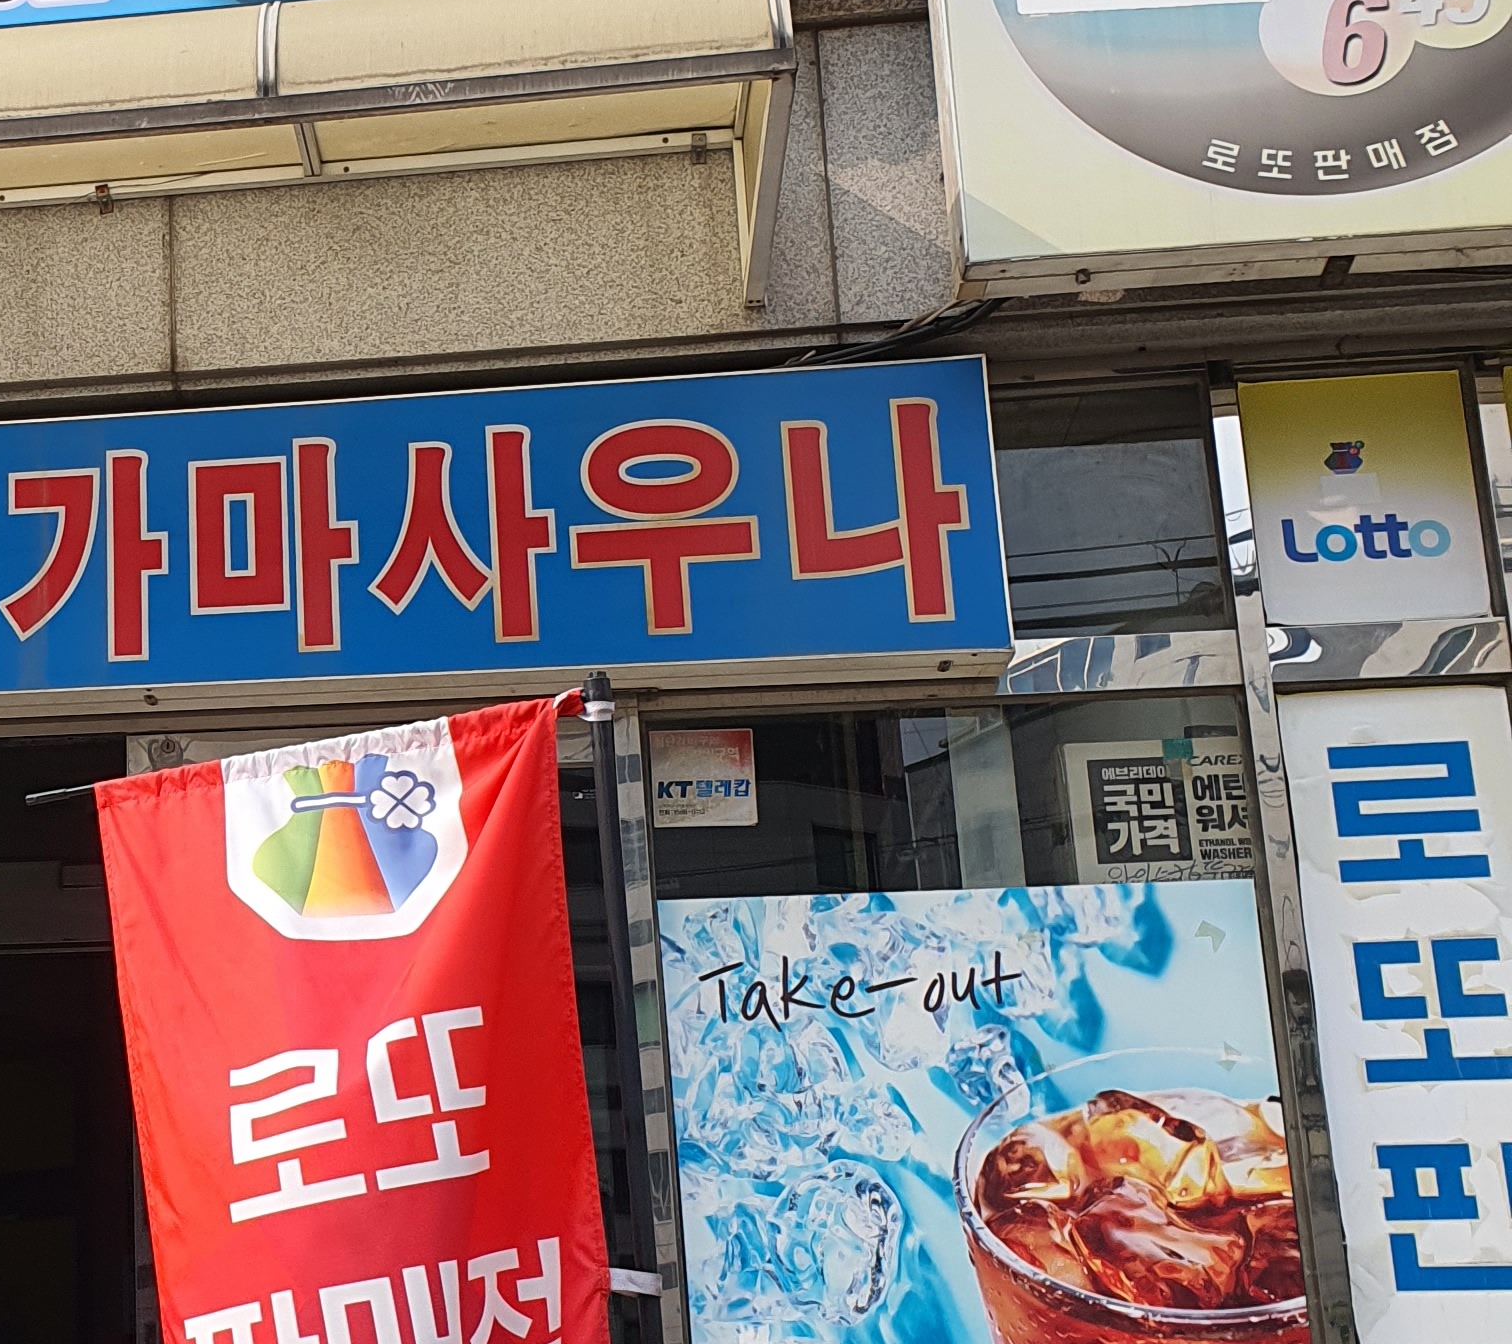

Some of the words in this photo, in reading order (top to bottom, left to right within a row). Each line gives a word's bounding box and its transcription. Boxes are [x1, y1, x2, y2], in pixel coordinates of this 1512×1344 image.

[1201, 119, 1459, 181] 로또판매점
[1281, 512, 1452, 564] Lotto
[1103, 782, 1176, 817] 국민
[1107, 818, 1181, 856] 가격
[1200, 847, 1253, 861] WASHER
[699, 950, 1022, 1033] Take-out
[229, 1005, 492, 1223] 로또
